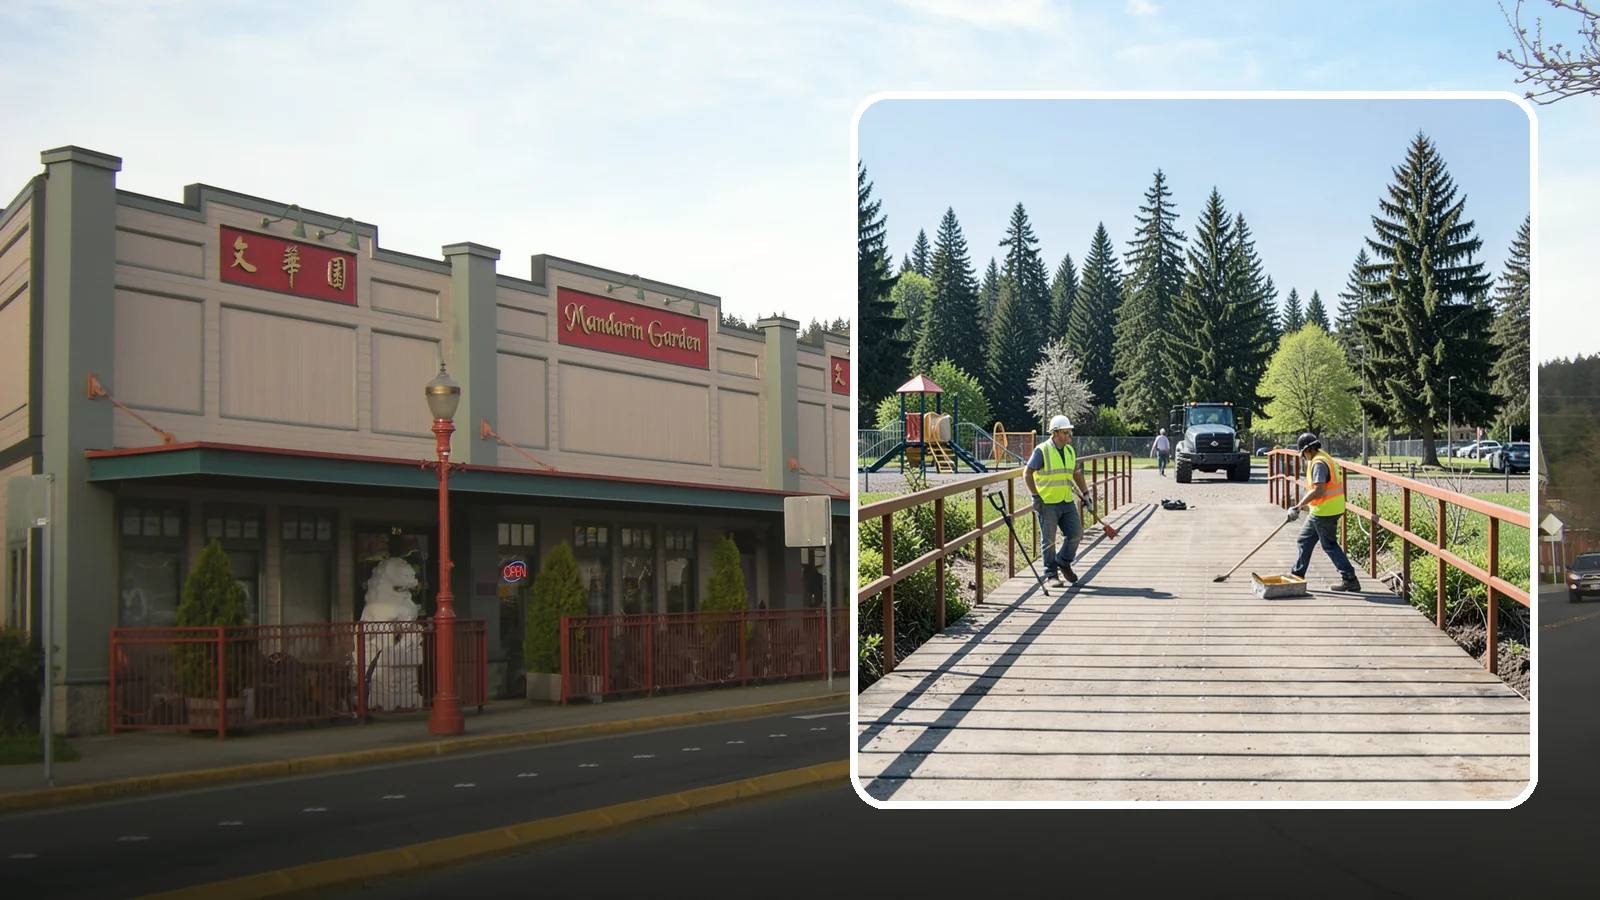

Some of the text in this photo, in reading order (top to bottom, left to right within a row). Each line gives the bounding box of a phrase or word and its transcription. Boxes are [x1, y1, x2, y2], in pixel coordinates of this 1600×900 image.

[230, 235, 346, 291] 文華園
[564, 302, 701, 352] Mandarin Garden
[503, 565, 527, 578] OPEN
